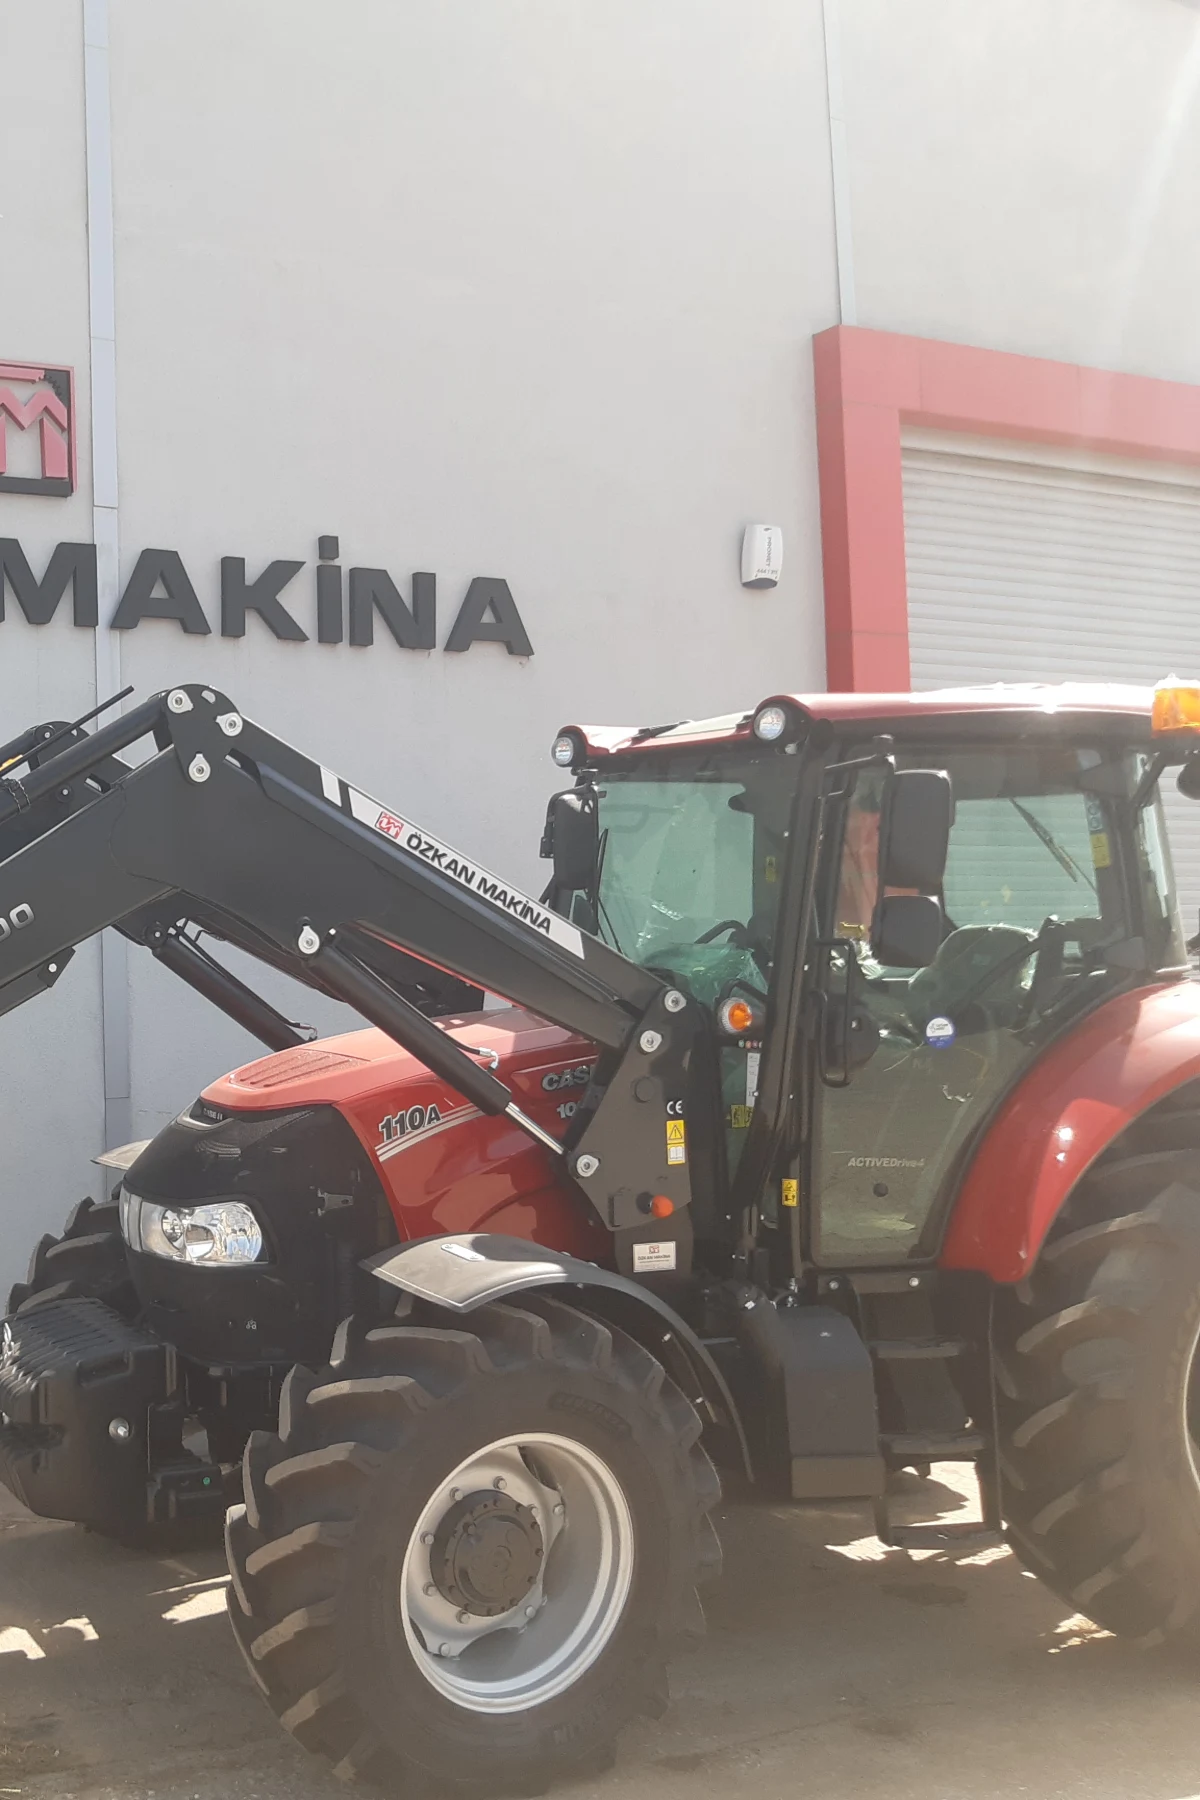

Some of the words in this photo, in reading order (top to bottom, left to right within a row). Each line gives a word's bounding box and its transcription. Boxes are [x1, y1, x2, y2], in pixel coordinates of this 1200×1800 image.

[406, 831, 476, 885] ÖZKAN
[476, 876, 552, 935] MAKİNA
[541, 1065, 592, 1091] CAS
[378, 1104, 442, 1142] 110A
